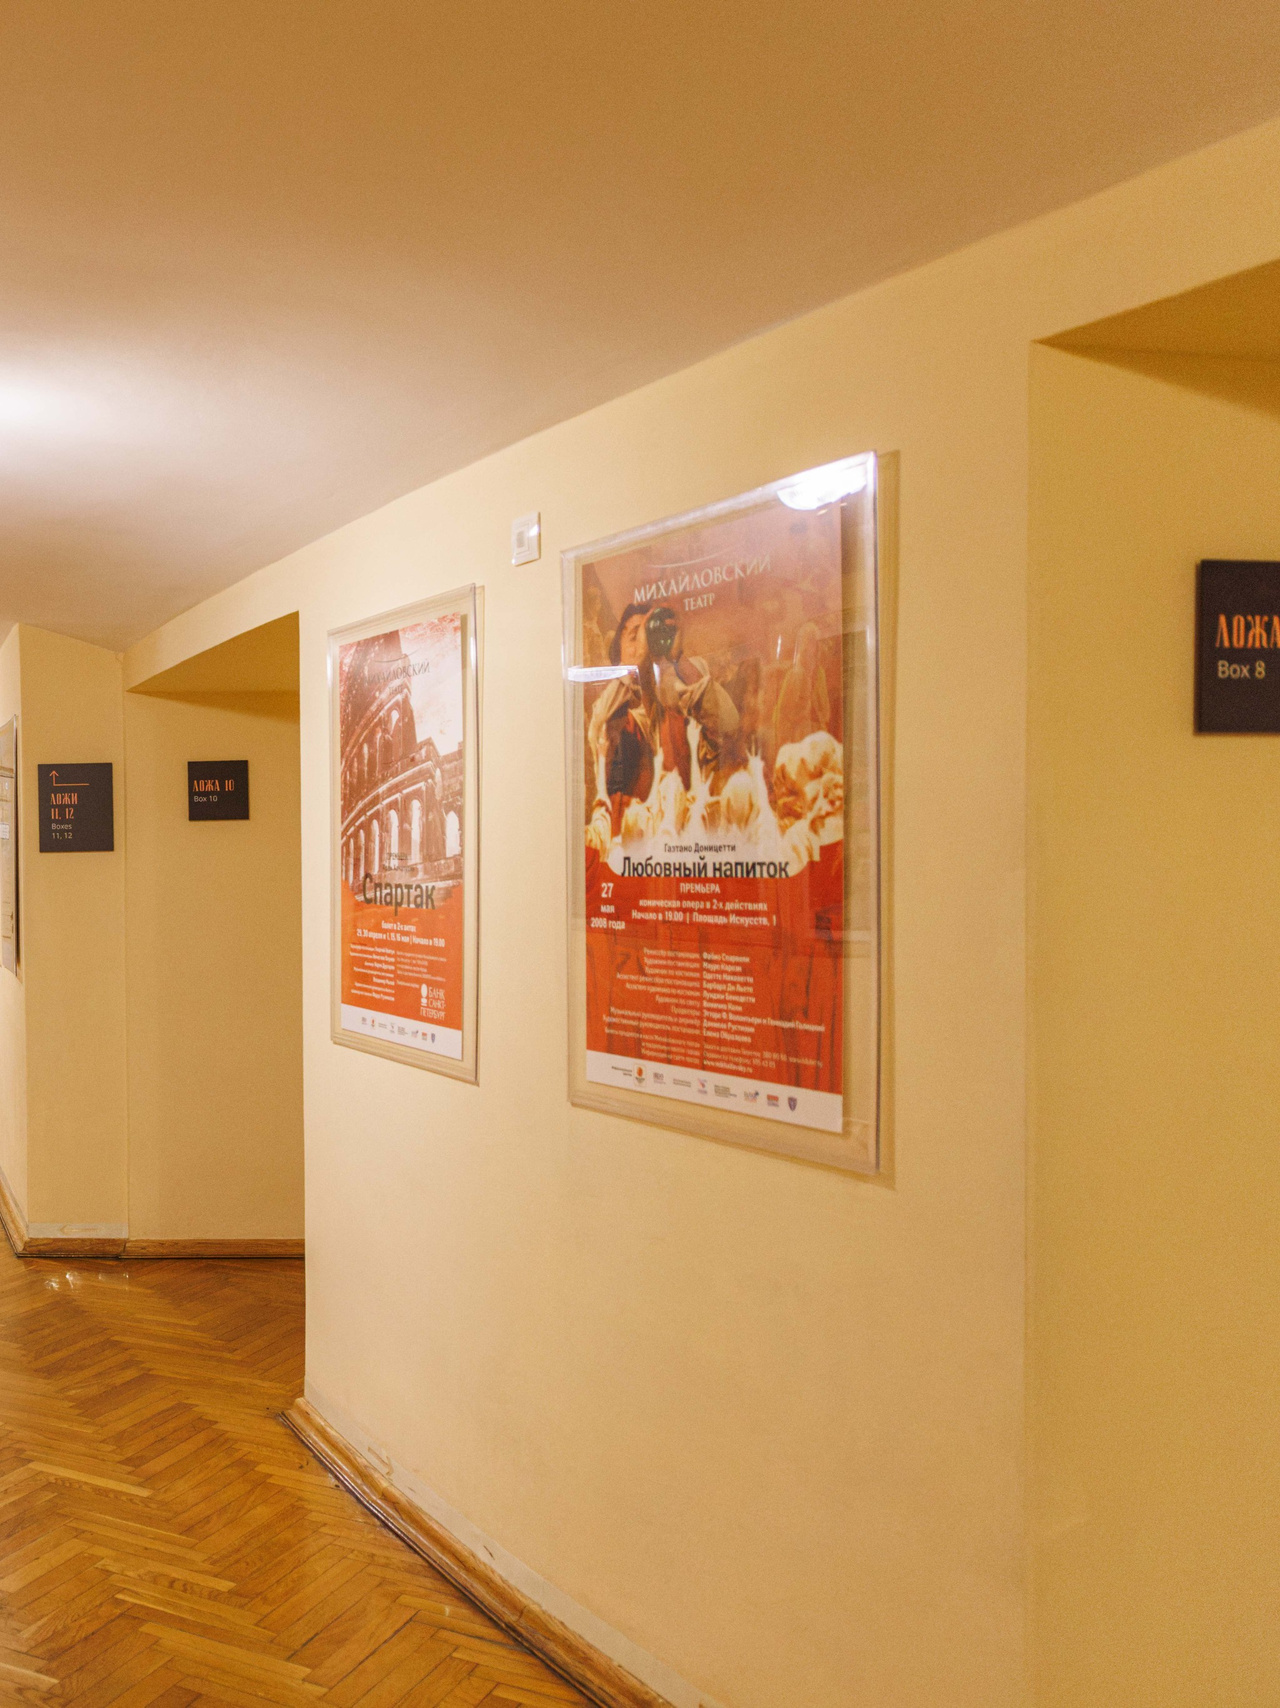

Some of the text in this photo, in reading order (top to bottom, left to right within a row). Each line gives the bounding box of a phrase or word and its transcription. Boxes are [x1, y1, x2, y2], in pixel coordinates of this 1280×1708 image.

[633, 554, 771, 604] МИХАЙЛОВСКИЙ
[683, 592, 716, 611] ТЕАТР
[1215, 613, 1280, 649] ЛОЖА
[1217, 659, 1266, 679] Box 8
[193, 778, 235, 792] ЛОЖА 10
[50, 793, 78, 806] ЛОЖИ
[193, 795, 208, 803] Box
[65, 807, 74, 819] 12
[664, 843, 736, 854] Гаэтано Доницетти
[621, 856, 790, 878] Любовный напиток
[362, 872, 436, 917] Спартак
[601, 883, 614, 898] 27
[679, 882, 721, 894] ПРЕМЬЕРА
[600, 904, 615, 913] мая
[639, 899, 681, 910] комическая
[682, 901, 704, 912] опера
[713, 899, 723, 910] 2-х
[725, 901, 768, 912] действиях
[590, 917, 626, 930] 2008 года
[632, 909, 656, 921] Начало
[664, 910, 683, 922] 19.00
[692, 913, 728, 925] Площадь
[729, 915, 770, 927] Искусств,
[428, 986, 445, 1000] БАНК
